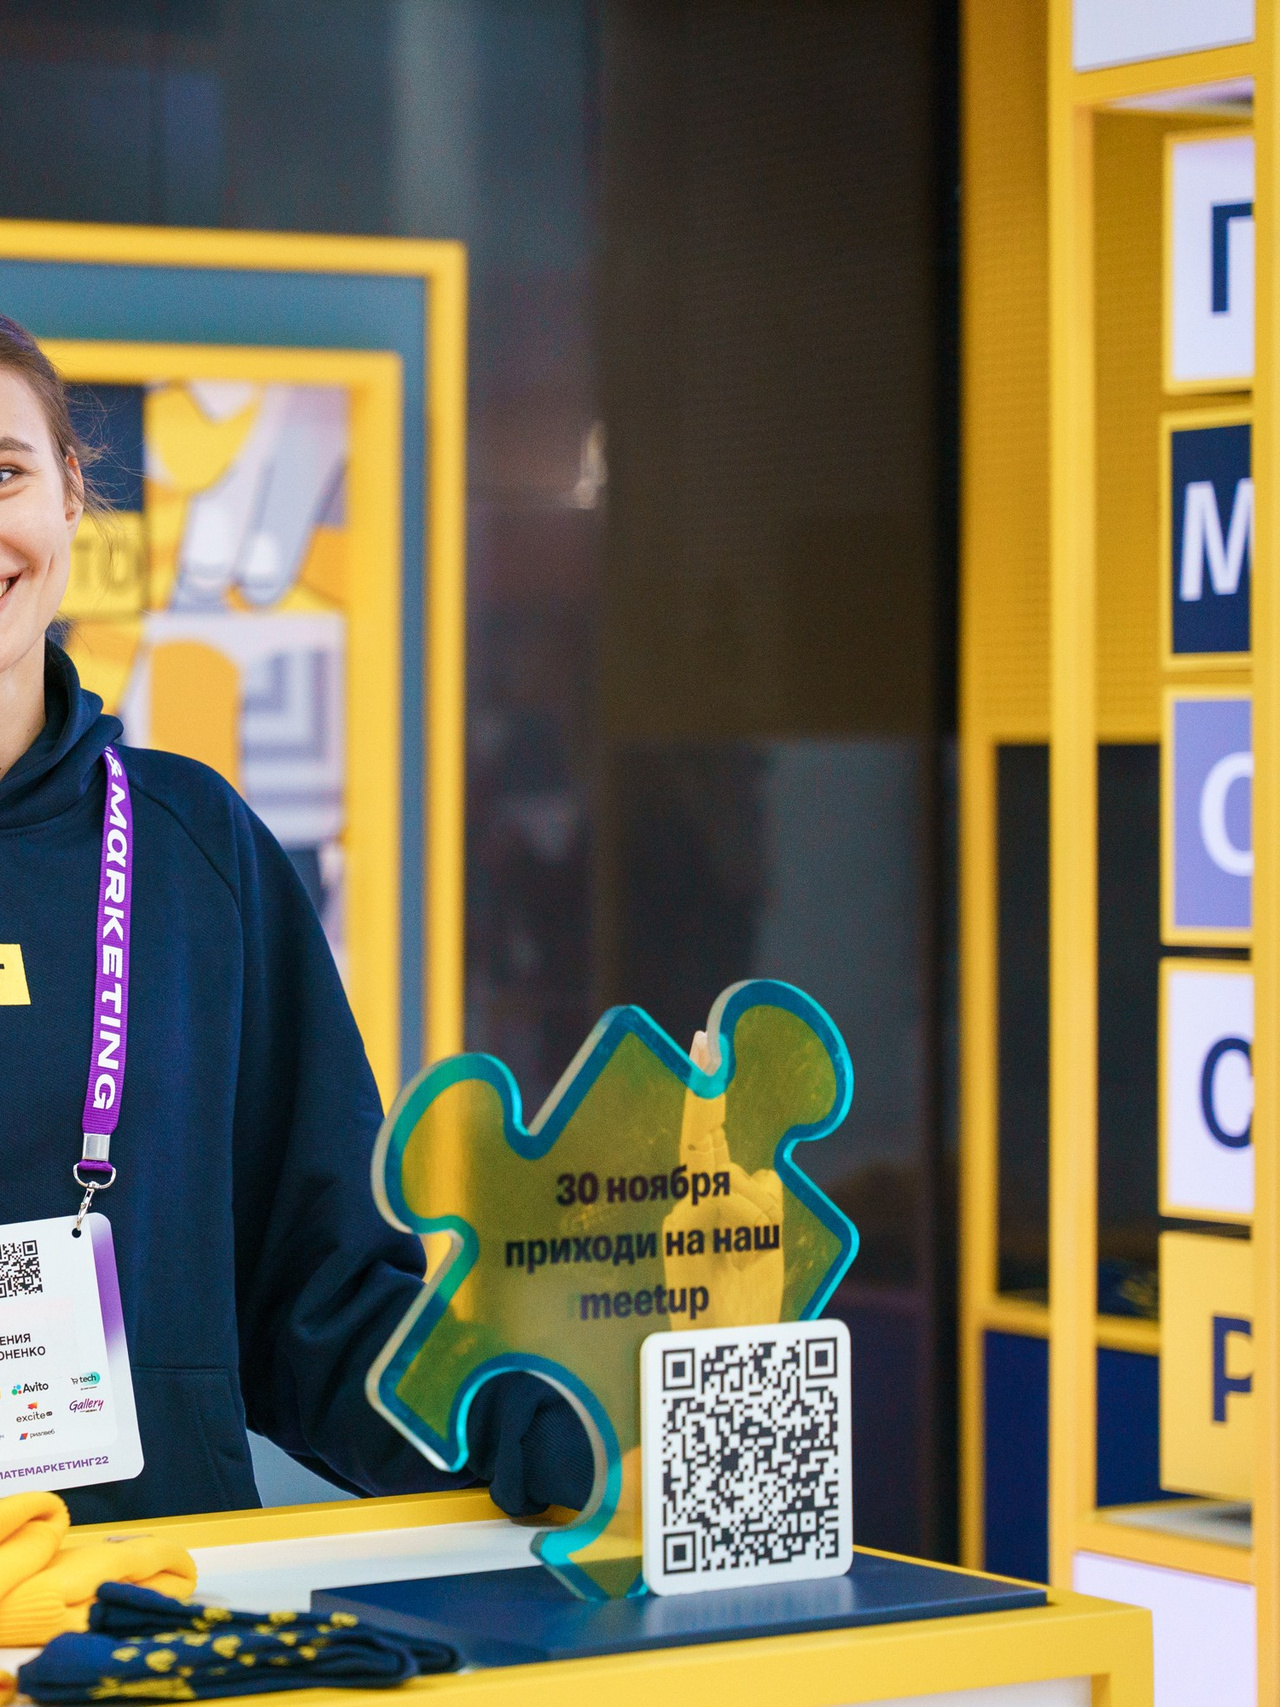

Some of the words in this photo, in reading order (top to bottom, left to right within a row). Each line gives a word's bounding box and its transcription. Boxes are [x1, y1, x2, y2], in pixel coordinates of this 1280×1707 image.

[556, 1171, 599, 1207] 30
[607, 1165, 731, 1206] ноября
[505, 1230, 658, 1275] приходи
[665, 1228, 705, 1257] на
[712, 1224, 780, 1254] наш
[579, 1283, 710, 1321] meetup
[22, 1381, 50, 1394] Avito
[16, 1411, 46, 1423] excite
[69, 1398, 104, 1413] Gallery
